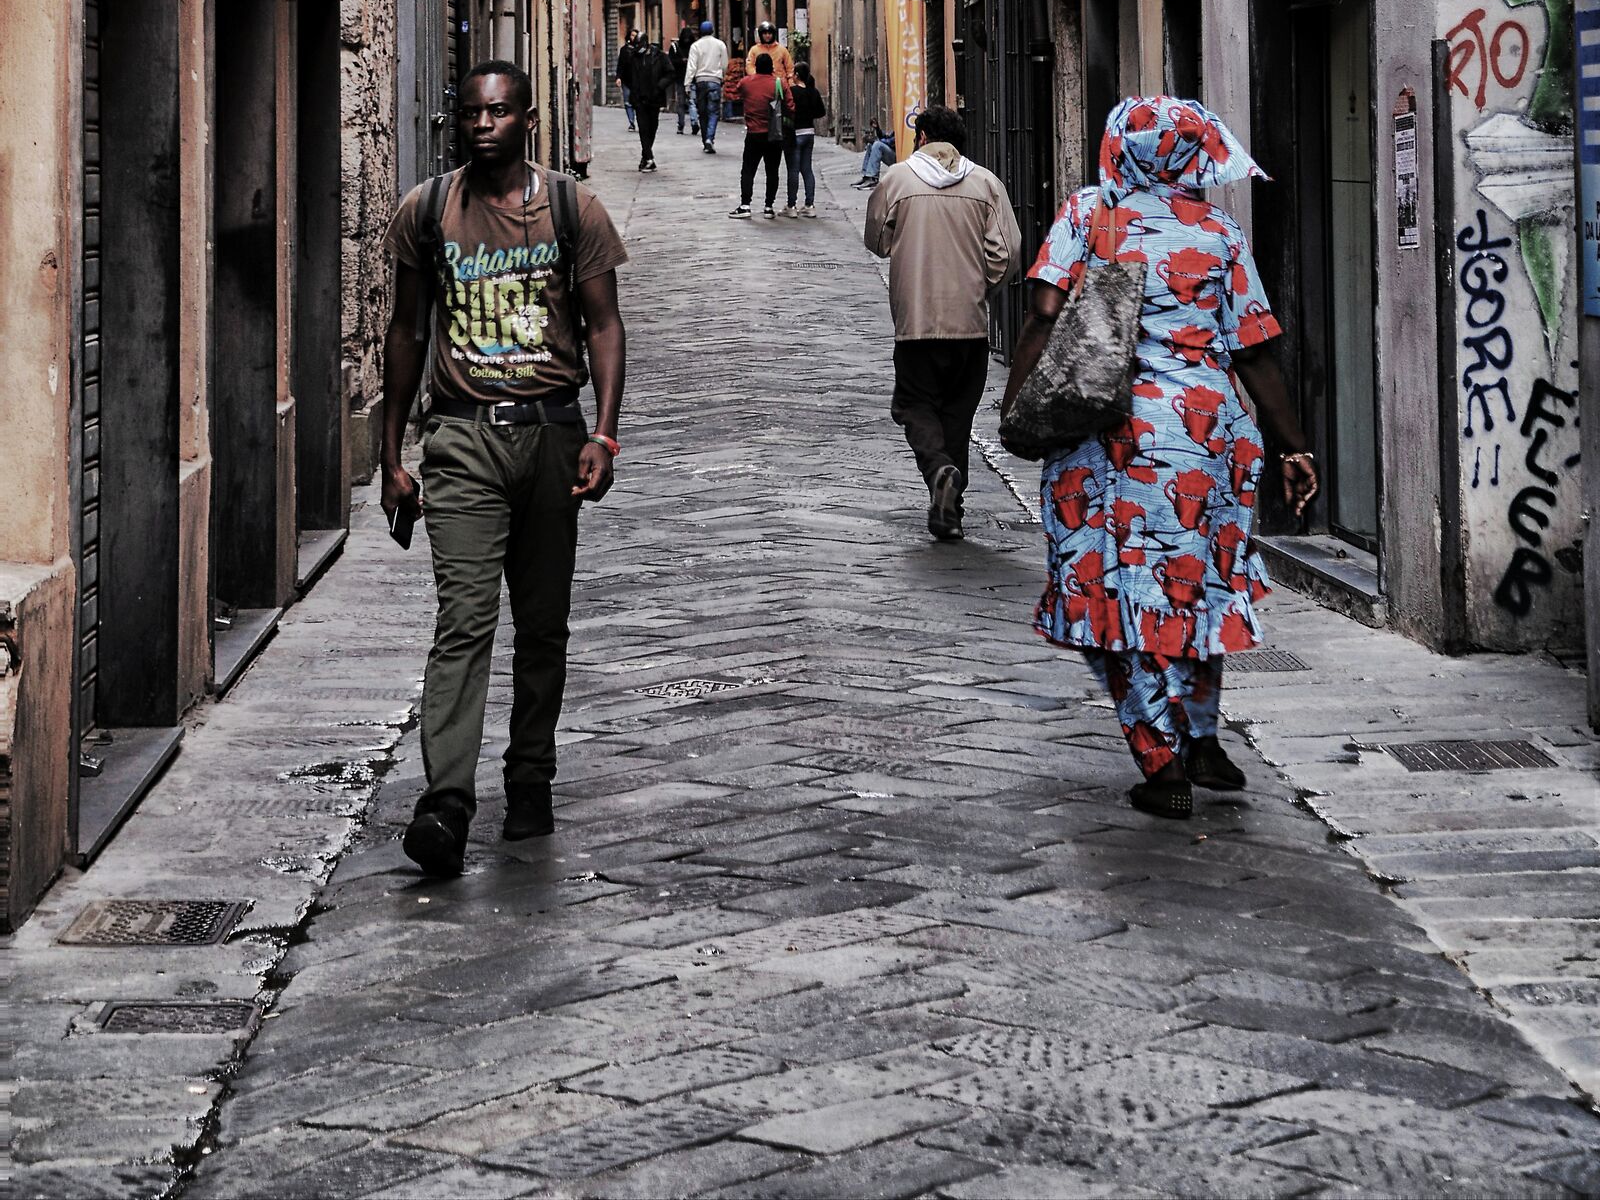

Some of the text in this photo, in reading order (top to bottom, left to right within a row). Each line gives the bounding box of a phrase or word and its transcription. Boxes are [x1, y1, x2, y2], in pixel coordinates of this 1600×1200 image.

[465, 351, 505, 365] brave
[469, 365, 537, 379] Cotton & Silk
